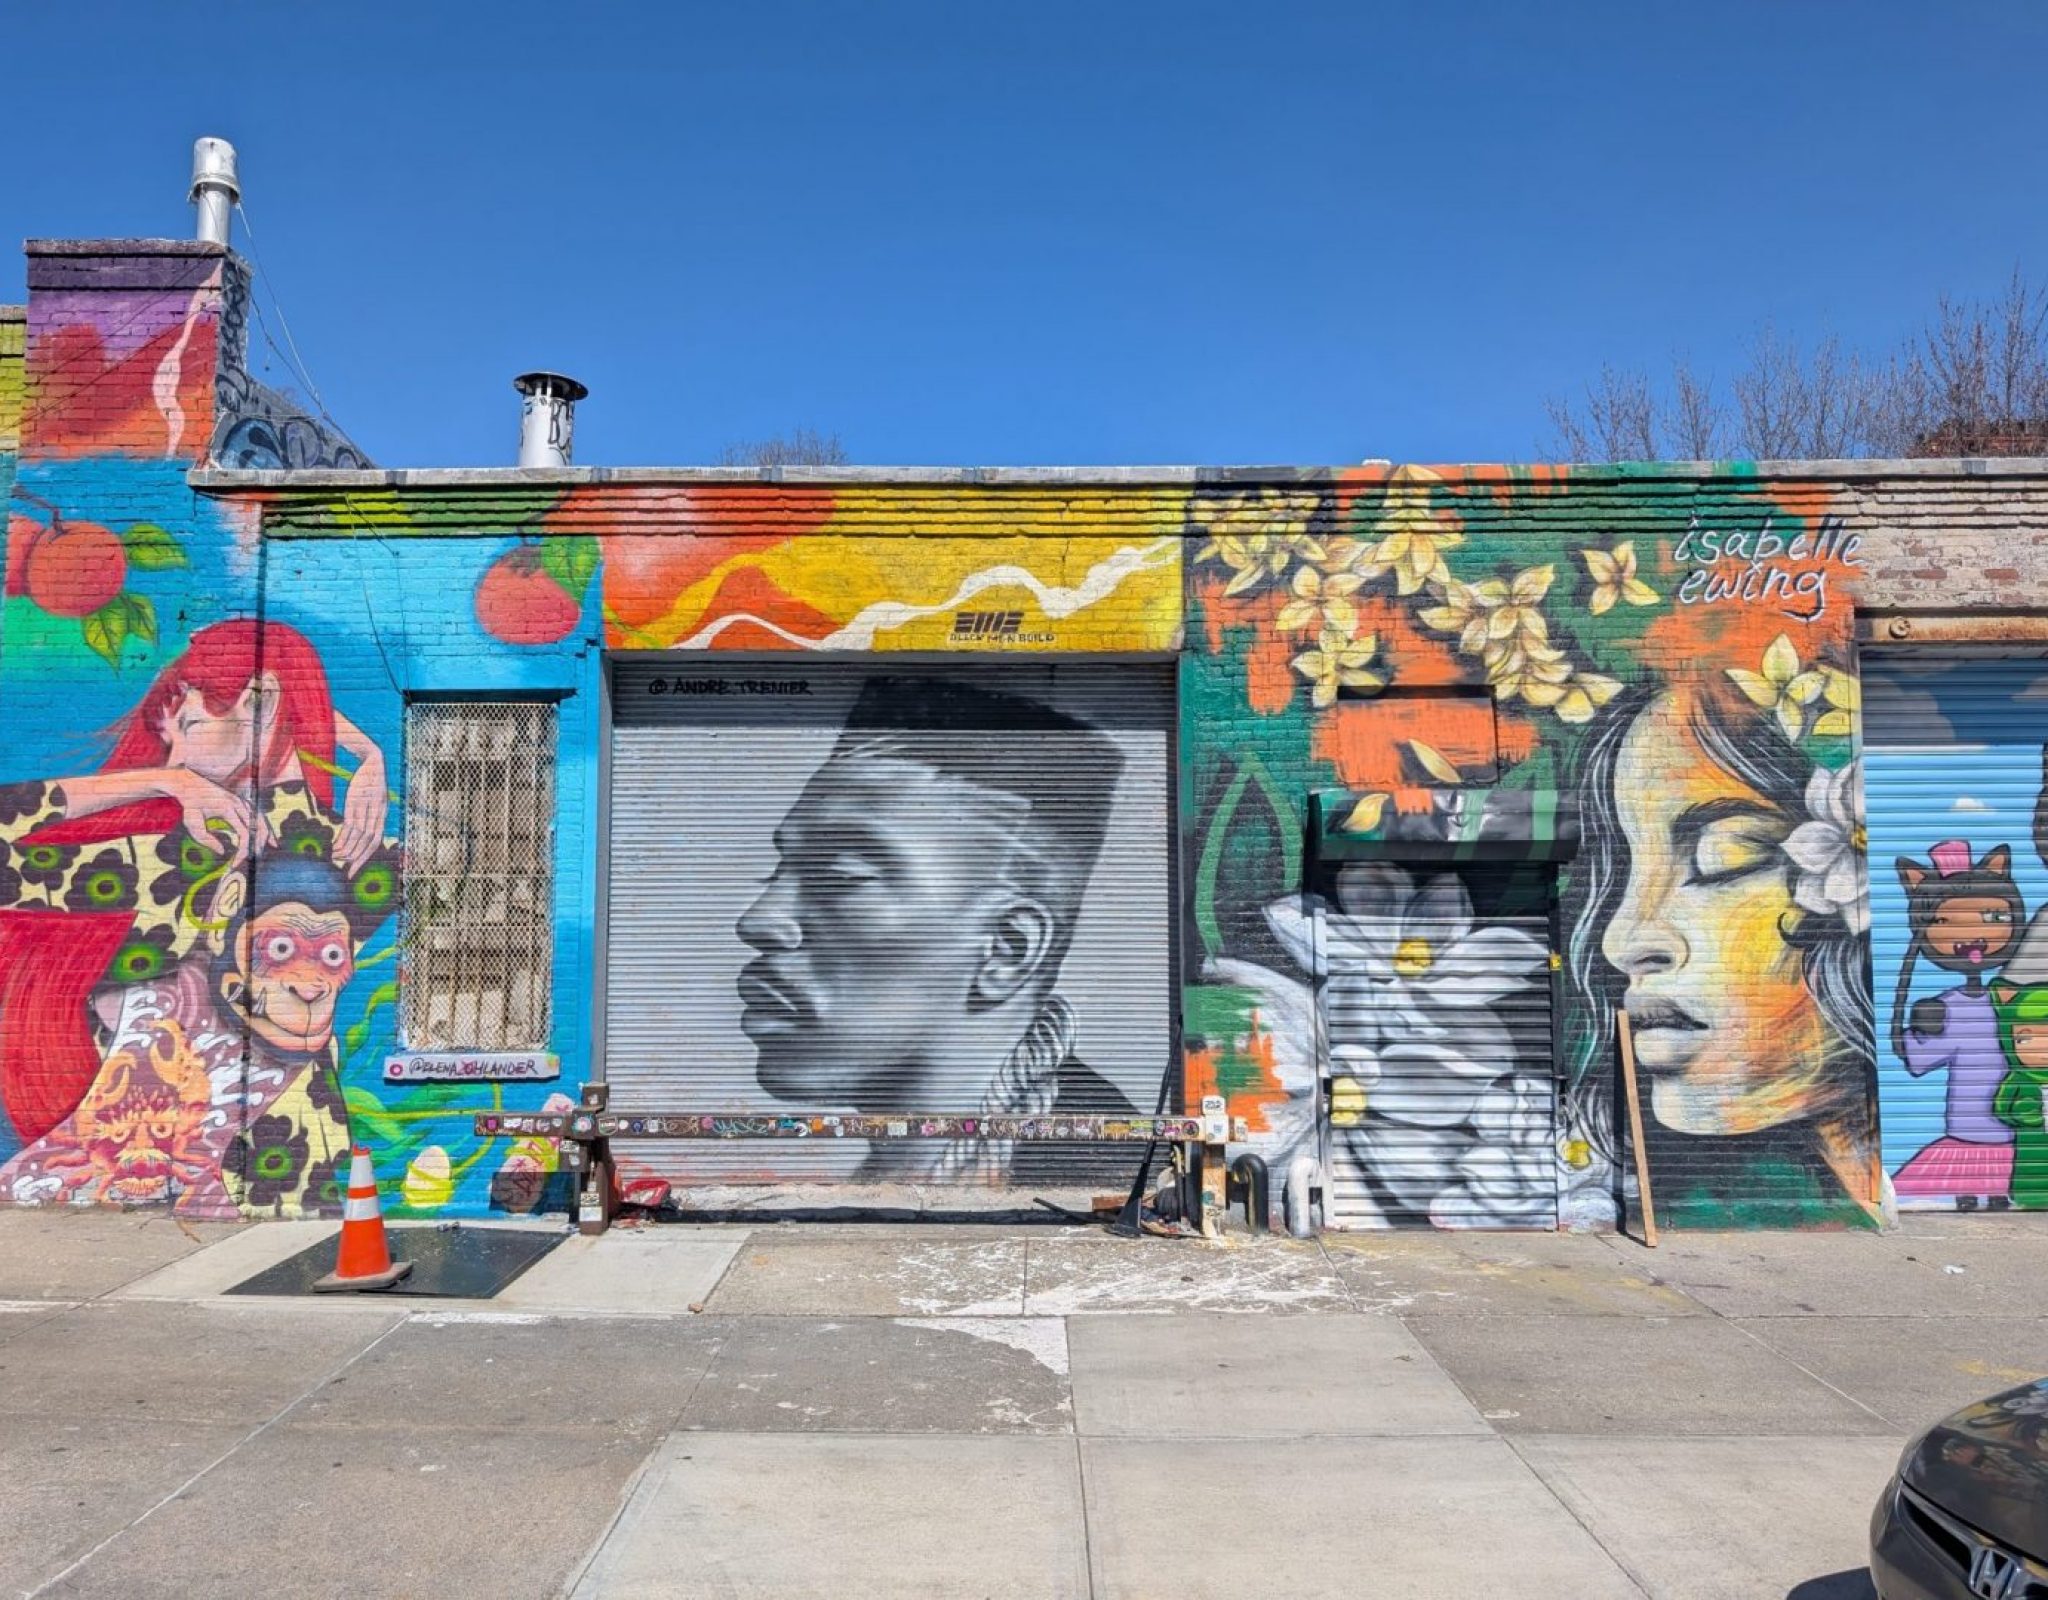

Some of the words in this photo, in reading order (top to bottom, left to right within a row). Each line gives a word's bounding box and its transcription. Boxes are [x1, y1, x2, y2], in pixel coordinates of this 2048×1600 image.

[1674, 511, 1867, 567] isabelle
[1677, 560, 1827, 623] ewing
[1018, 633, 1055, 643] BUILD
